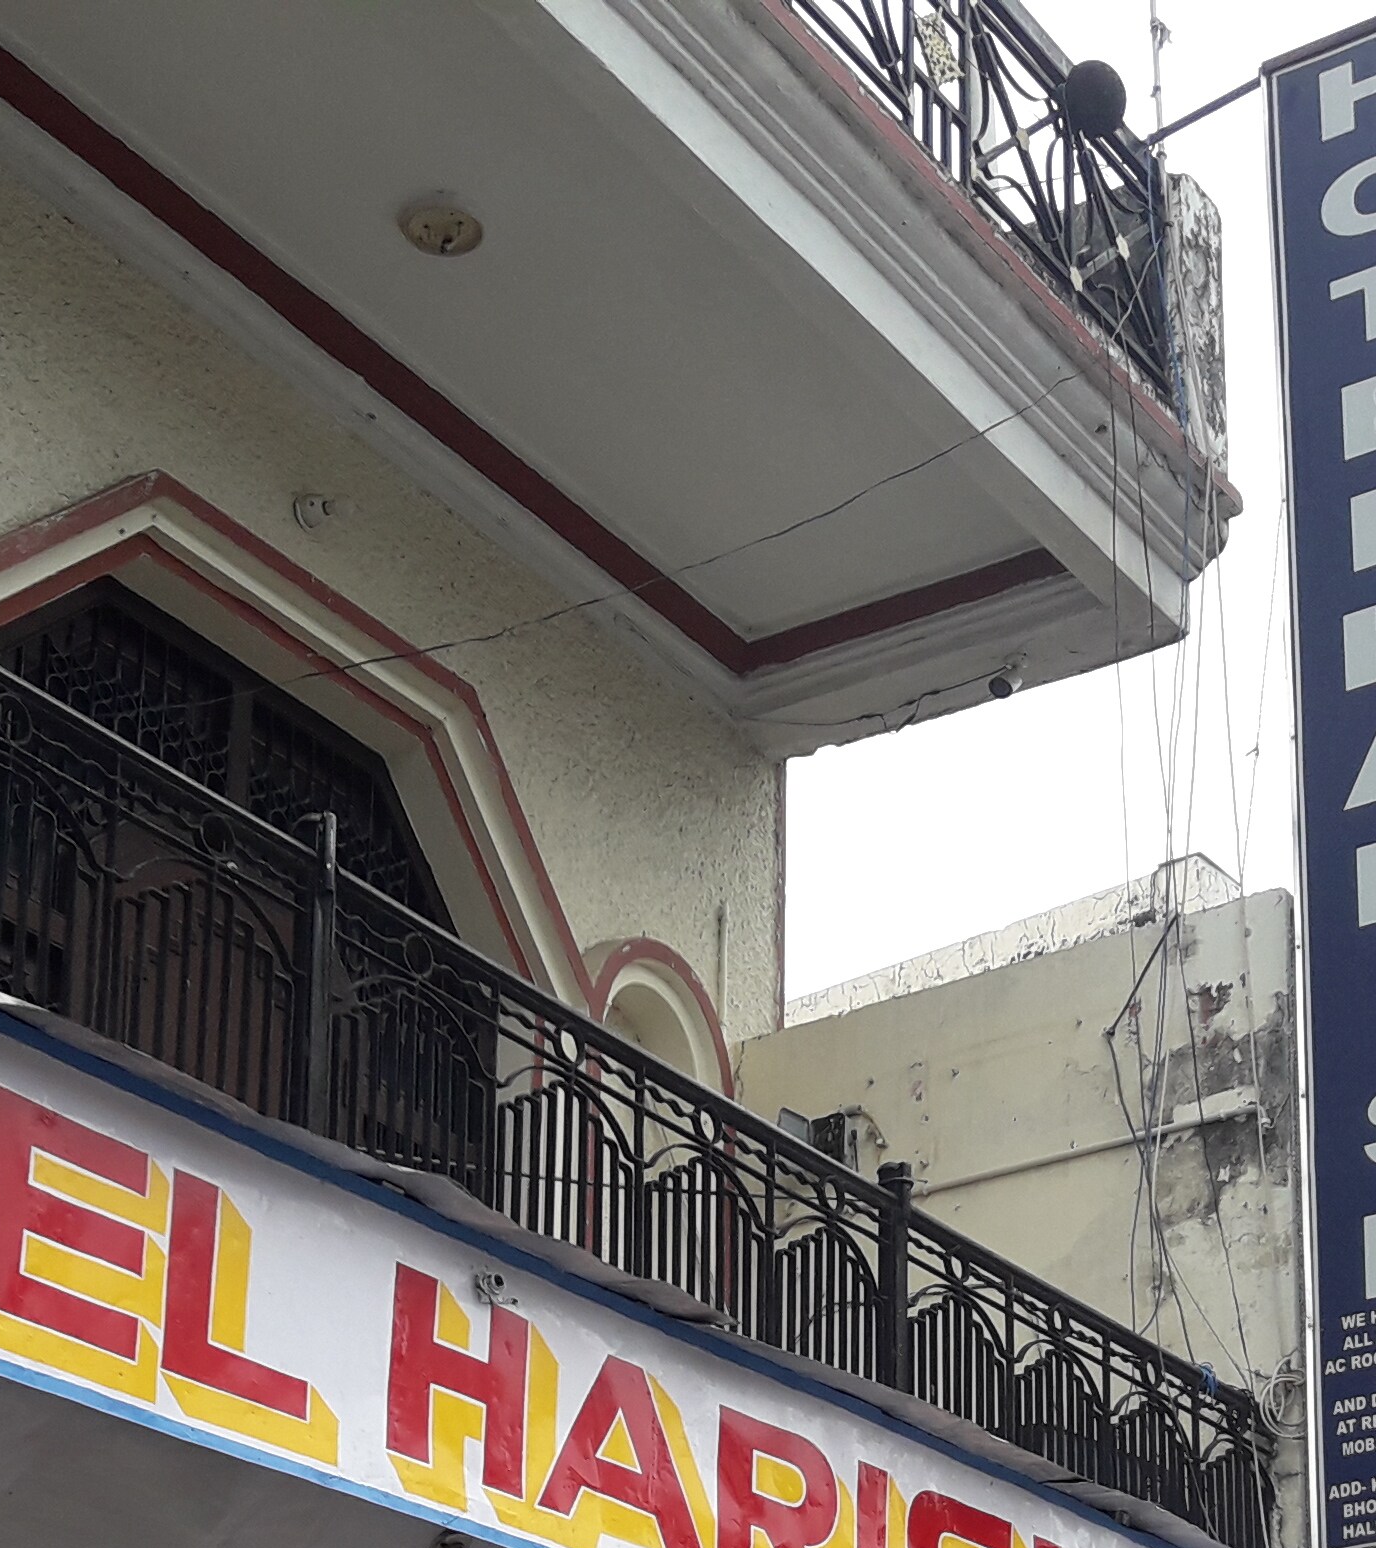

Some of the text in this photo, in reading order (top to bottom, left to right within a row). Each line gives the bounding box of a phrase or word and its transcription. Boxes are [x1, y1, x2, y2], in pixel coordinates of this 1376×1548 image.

[1341, 1314, 1365, 1331] WE
[1343, 1332, 1372, 1351] ALL
[1325, 1358, 1347, 1376] AC
[1333, 1397, 1366, 1415] AND
[1336, 1419, 1357, 1435] AT
[1329, 1482, 1366, 1499] ADD-
